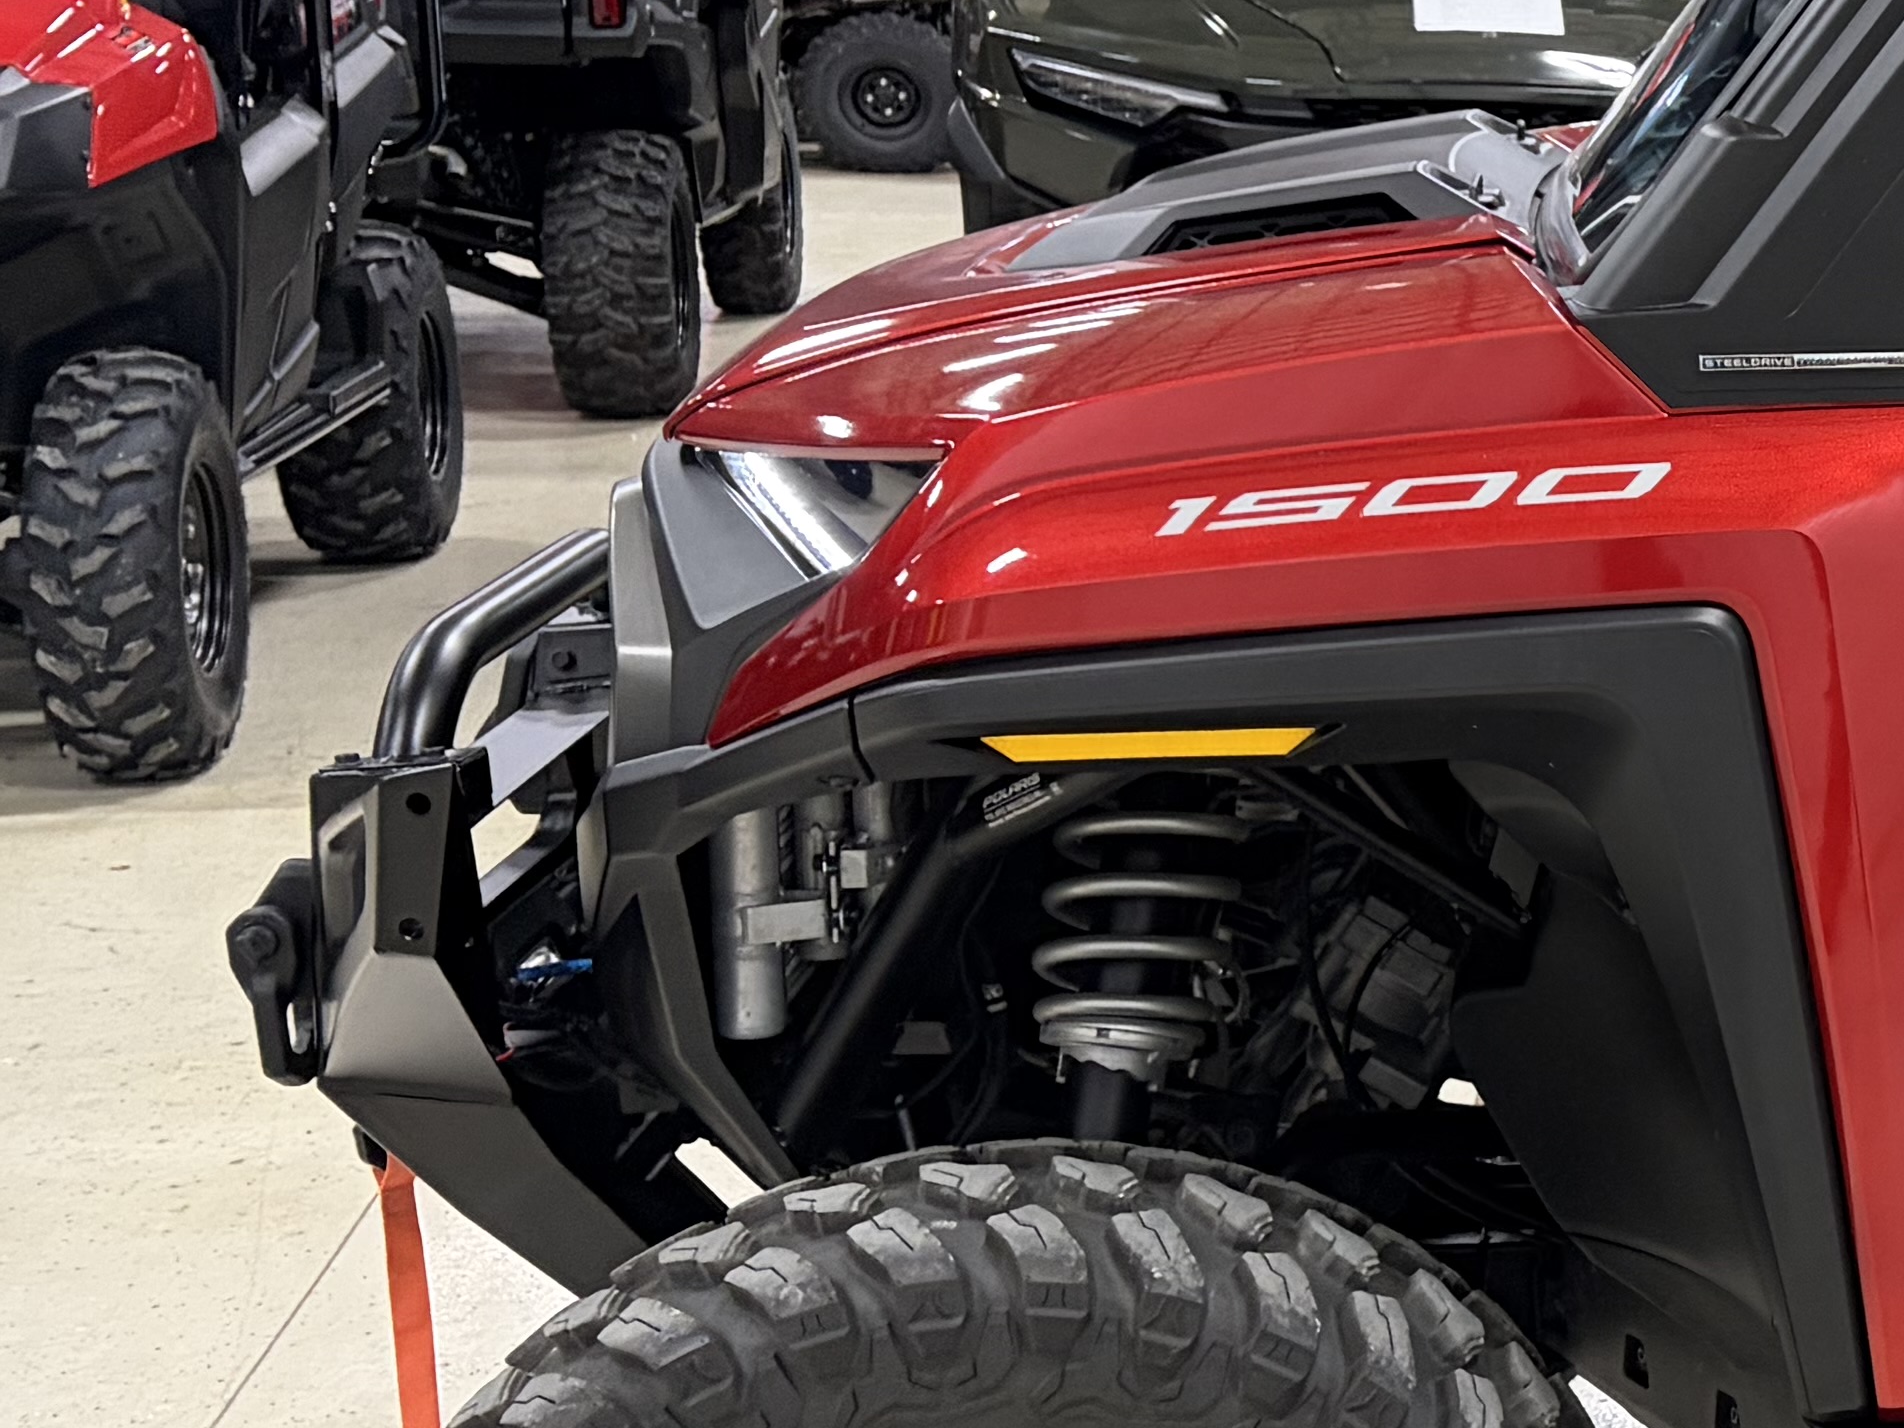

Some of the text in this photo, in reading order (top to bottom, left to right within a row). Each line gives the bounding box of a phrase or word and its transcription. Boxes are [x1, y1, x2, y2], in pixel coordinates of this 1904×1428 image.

[1703, 356, 1794, 369] STEELDRIVE
[1154, 461, 1672, 537] 1500
[982, 772, 1041, 809] POLARIS
